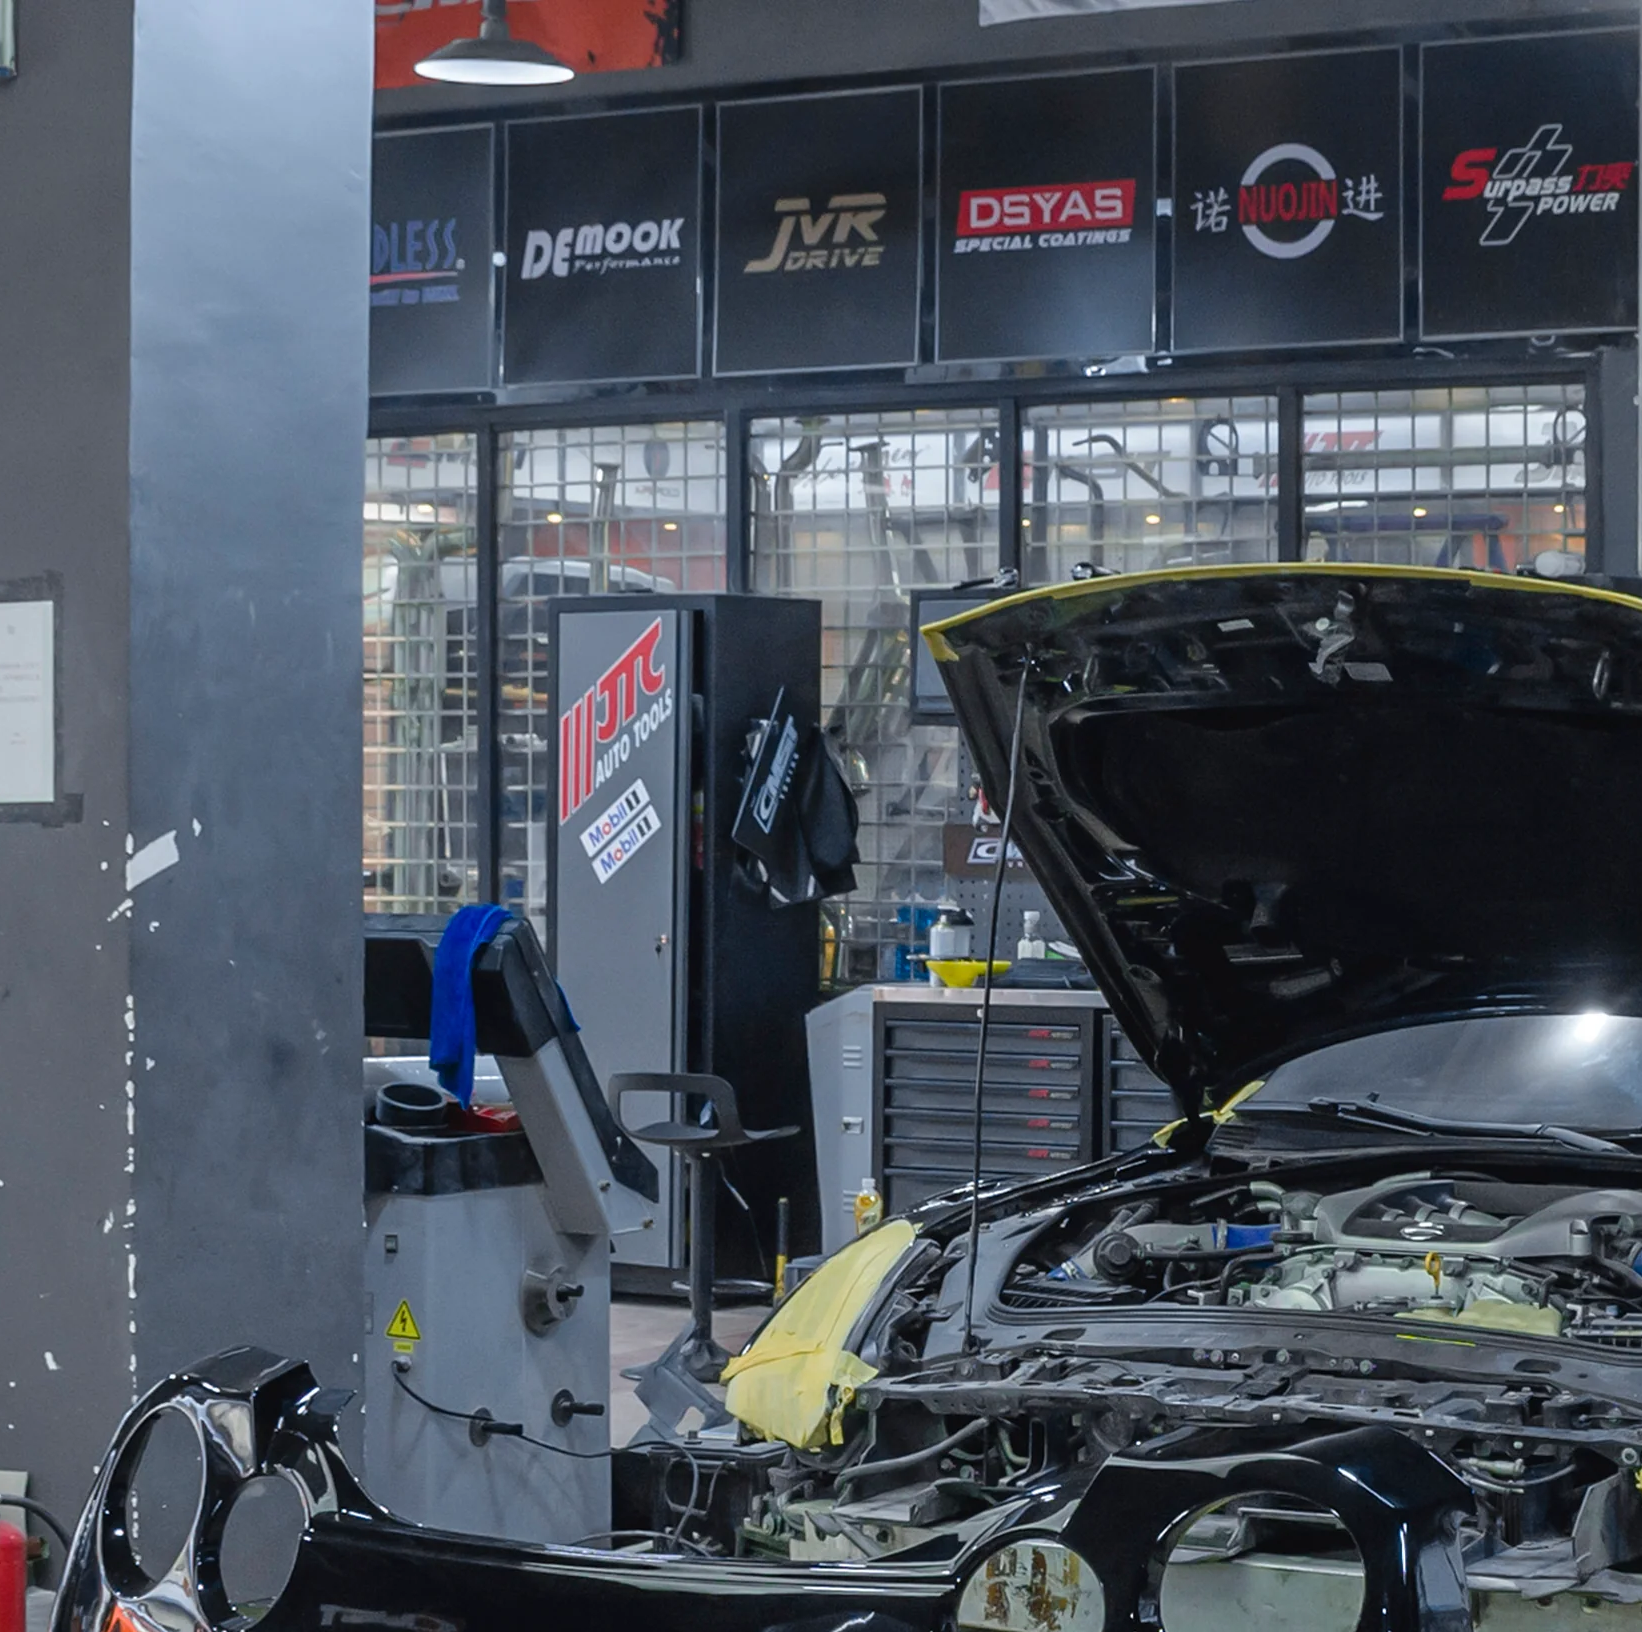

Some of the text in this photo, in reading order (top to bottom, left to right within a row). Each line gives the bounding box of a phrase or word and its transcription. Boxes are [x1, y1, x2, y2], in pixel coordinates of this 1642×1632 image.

[970, 187, 1124, 230] DSYAS
[1189, 173, 1385, 234] 诺 NUOJIN 进
[1536, 192, 1620, 216] POWER
[744, 193, 888, 273] JVR
[954, 228, 1132, 254] SPECIAL COATINGS
[784, 246, 887, 272] DRIVE
[595, 687, 673, 790] AUTO TOOLS
[587, 801, 628, 849] Mobil
[599, 827, 640, 875] Mobil
